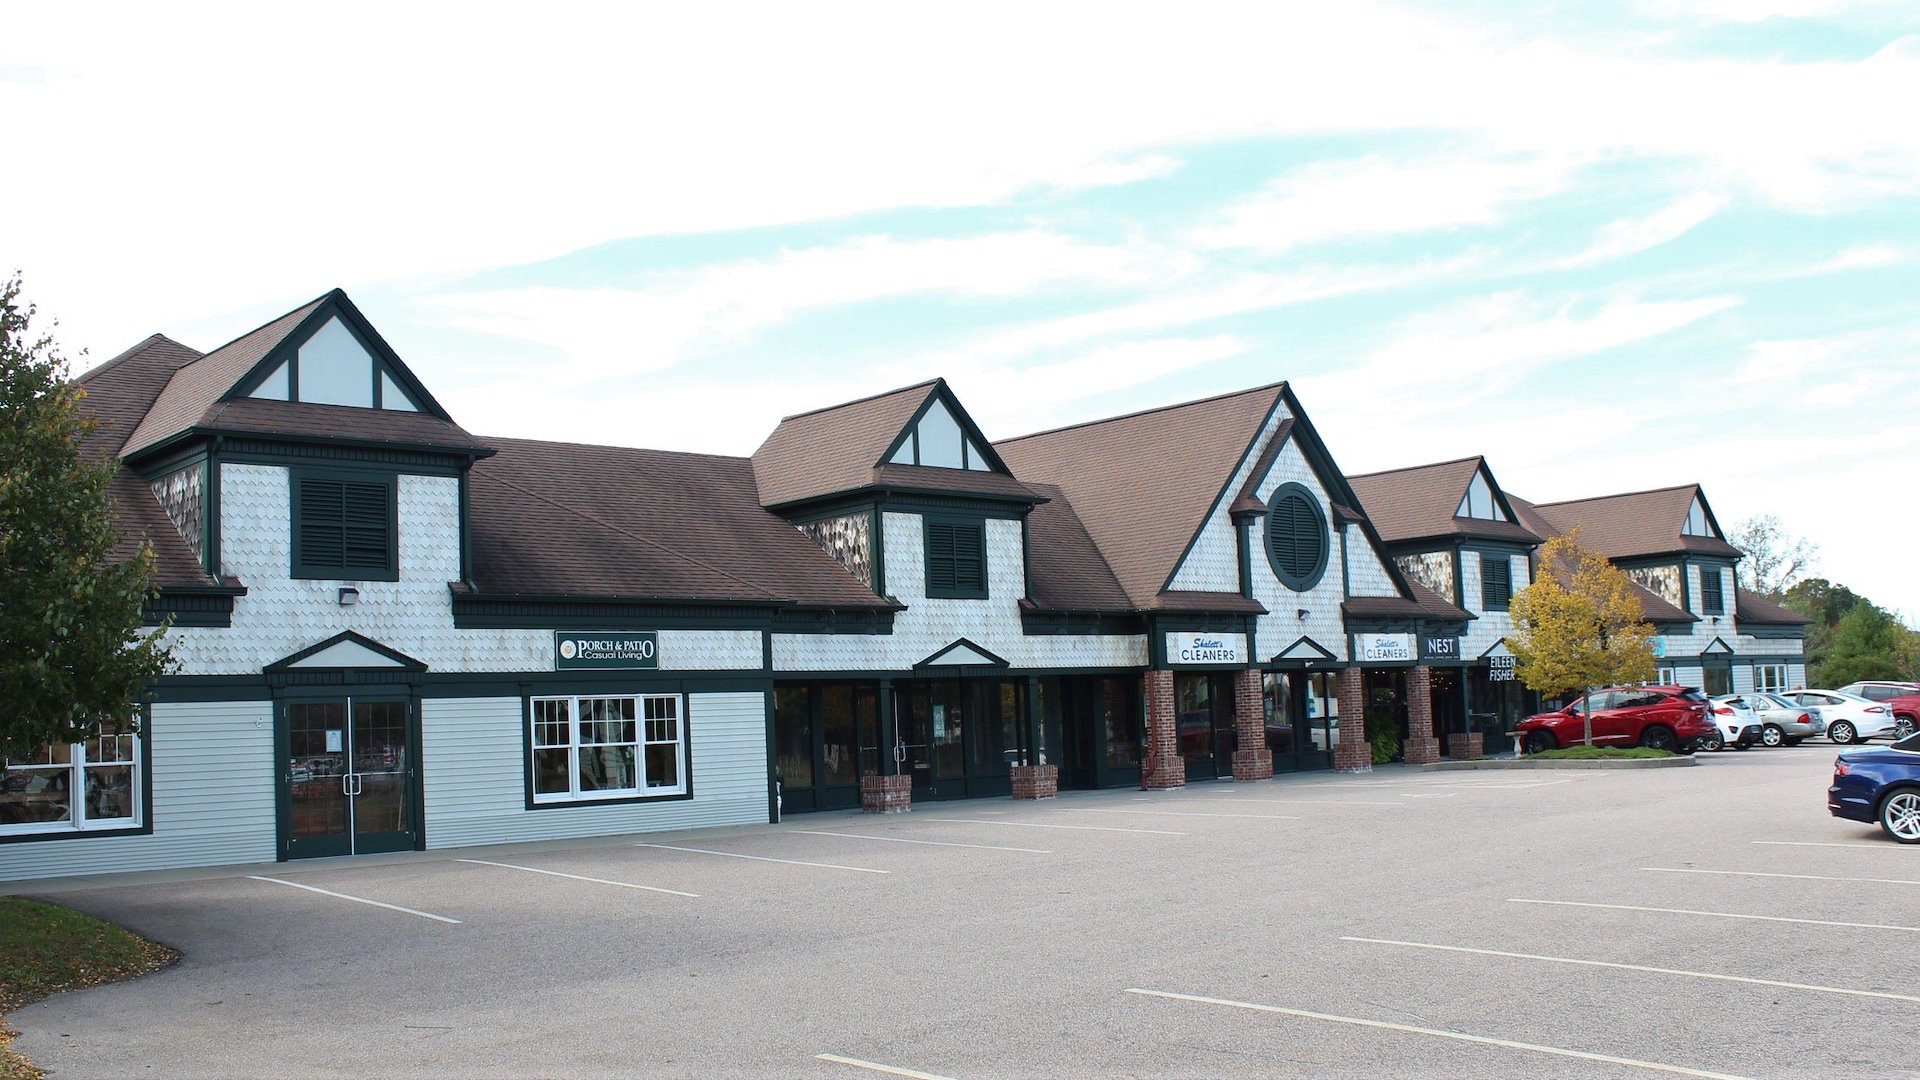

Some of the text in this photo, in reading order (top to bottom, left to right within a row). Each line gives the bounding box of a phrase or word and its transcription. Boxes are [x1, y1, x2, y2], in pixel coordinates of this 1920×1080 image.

[577, 640, 654, 659] PORCH & PATIO
[1428, 638, 1454, 653] NEST
[585, 651, 643, 660] Casual Living
[1181, 649, 1235, 661] CLEANERS
[1366, 649, 1408, 659] CLEANERS
[1490, 656, 1517, 668] EILEEN
